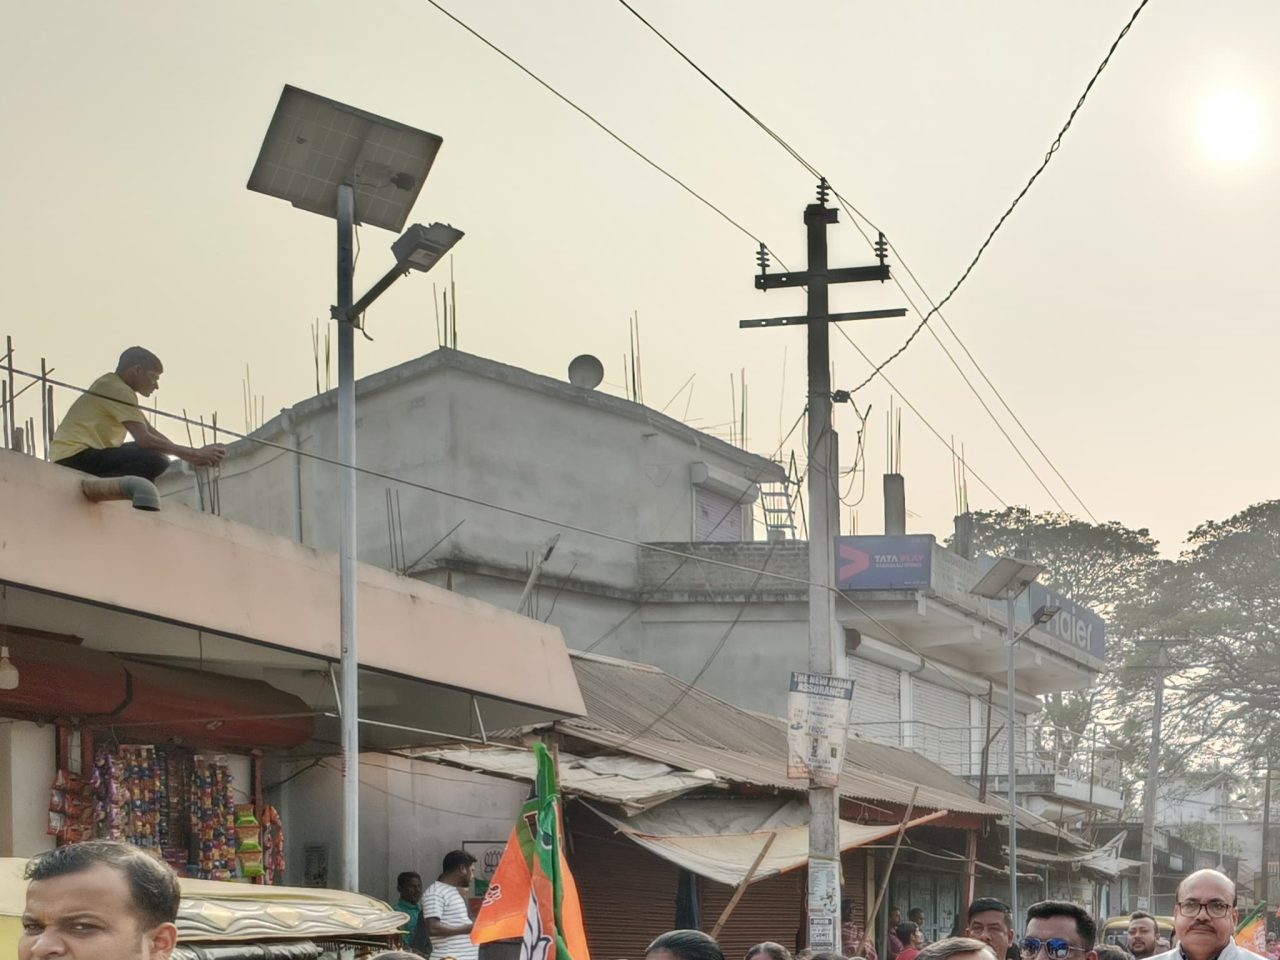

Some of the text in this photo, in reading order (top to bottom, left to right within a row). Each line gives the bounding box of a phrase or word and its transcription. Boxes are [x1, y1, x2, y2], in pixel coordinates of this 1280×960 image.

[874, 554, 898, 563] TATA
[793, 672, 852, 690] THE NEW INDIA
[796, 682, 848, 698] ASSURANCE
